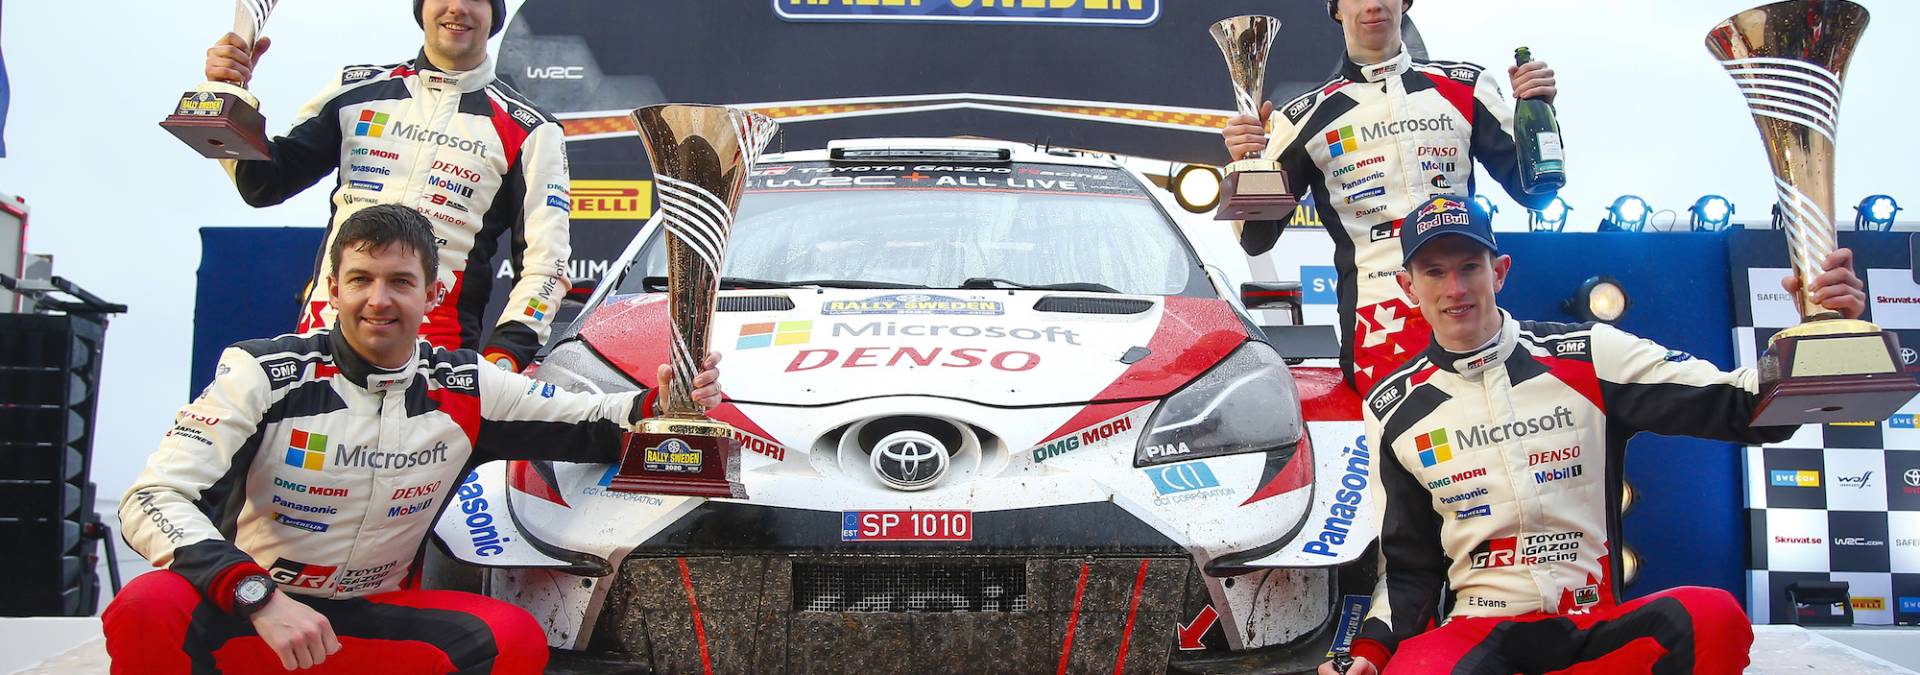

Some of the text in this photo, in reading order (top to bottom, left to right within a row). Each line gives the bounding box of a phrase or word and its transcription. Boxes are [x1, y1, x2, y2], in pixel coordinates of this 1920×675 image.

[345, 71, 371, 80] OMP
[527, 66, 584, 79] WRC
[1450, 70, 1474, 80] OMP
[1290, 99, 1311, 116] OMP
[513, 109, 537, 125] OMP
[1361, 113, 1454, 142] Microsoft
[391, 121, 488, 159] Microsoft
[369, 149, 399, 160] MORI
[431, 160, 481, 183] DENSO
[798, 165, 906, 174] TOYOTA
[913, 164, 1012, 174] GAZOO
[1333, 156, 1385, 178] DMG MORI
[428, 175, 462, 194] Mobil
[766, 176, 897, 187] WRC
[935, 175, 997, 187] ALL
[1007, 177, 1077, 190] LIVE
[1342, 171, 1385, 191] Panasonic
[569, 199, 638, 212] ELLI
[433, 211, 455, 223] AUTO
[1417, 213, 1469, 235] Red Bull
[830, 301, 996, 310] RALLY SWEDEN
[832, 322, 1081, 346] Microsoft
[1557, 343, 1586, 352] OMP
[784, 347, 1041, 373] DENSO
[271, 365, 298, 378] OMP
[446, 375, 474, 386] OMP
[1375, 389, 1399, 409] OMP
[175, 426, 202, 434] JAPAN
[1456, 406, 1574, 450] Microsoft
[174, 432, 213, 446] AIRLINES
[735, 432, 785, 461] MORI
[1032, 416, 1132, 463] DMG MORI
[334, 441, 448, 470] Microsoft
[647, 450, 700, 465] RALLY SWEDEN
[1147, 442, 1191, 458] PIAA
[1528, 446, 1581, 466] DENSO
[1428, 467, 1487, 490] DMG MORI
[1535, 468, 1570, 485] Mobil
[274, 476, 349, 497] DMG MORI
[392, 480, 442, 500] DENSO
[272, 495, 337, 514] Panasonic
[1153, 488, 1236, 506] CCI CORPORATION
[1303, 435, 1369, 558] Panasonic
[388, 503, 423, 518] Mobil
[458, 470, 511, 557] asonic
[862, 514, 900, 537] SP
[910, 514, 968, 537] 1010
[1524, 531, 1584, 545] TOYOTA
[1775, 536, 1822, 545] Skruvat.se
[1523, 541, 1580, 556] GAZOO
[1521, 552, 1578, 566] Racing
[270, 566, 327, 588] GR
[346, 560, 398, 577] TOYOTA
[336, 580, 383, 593] Racing
[340, 571, 389, 585] GAZOO
[1469, 597, 1507, 608] E. Evans
